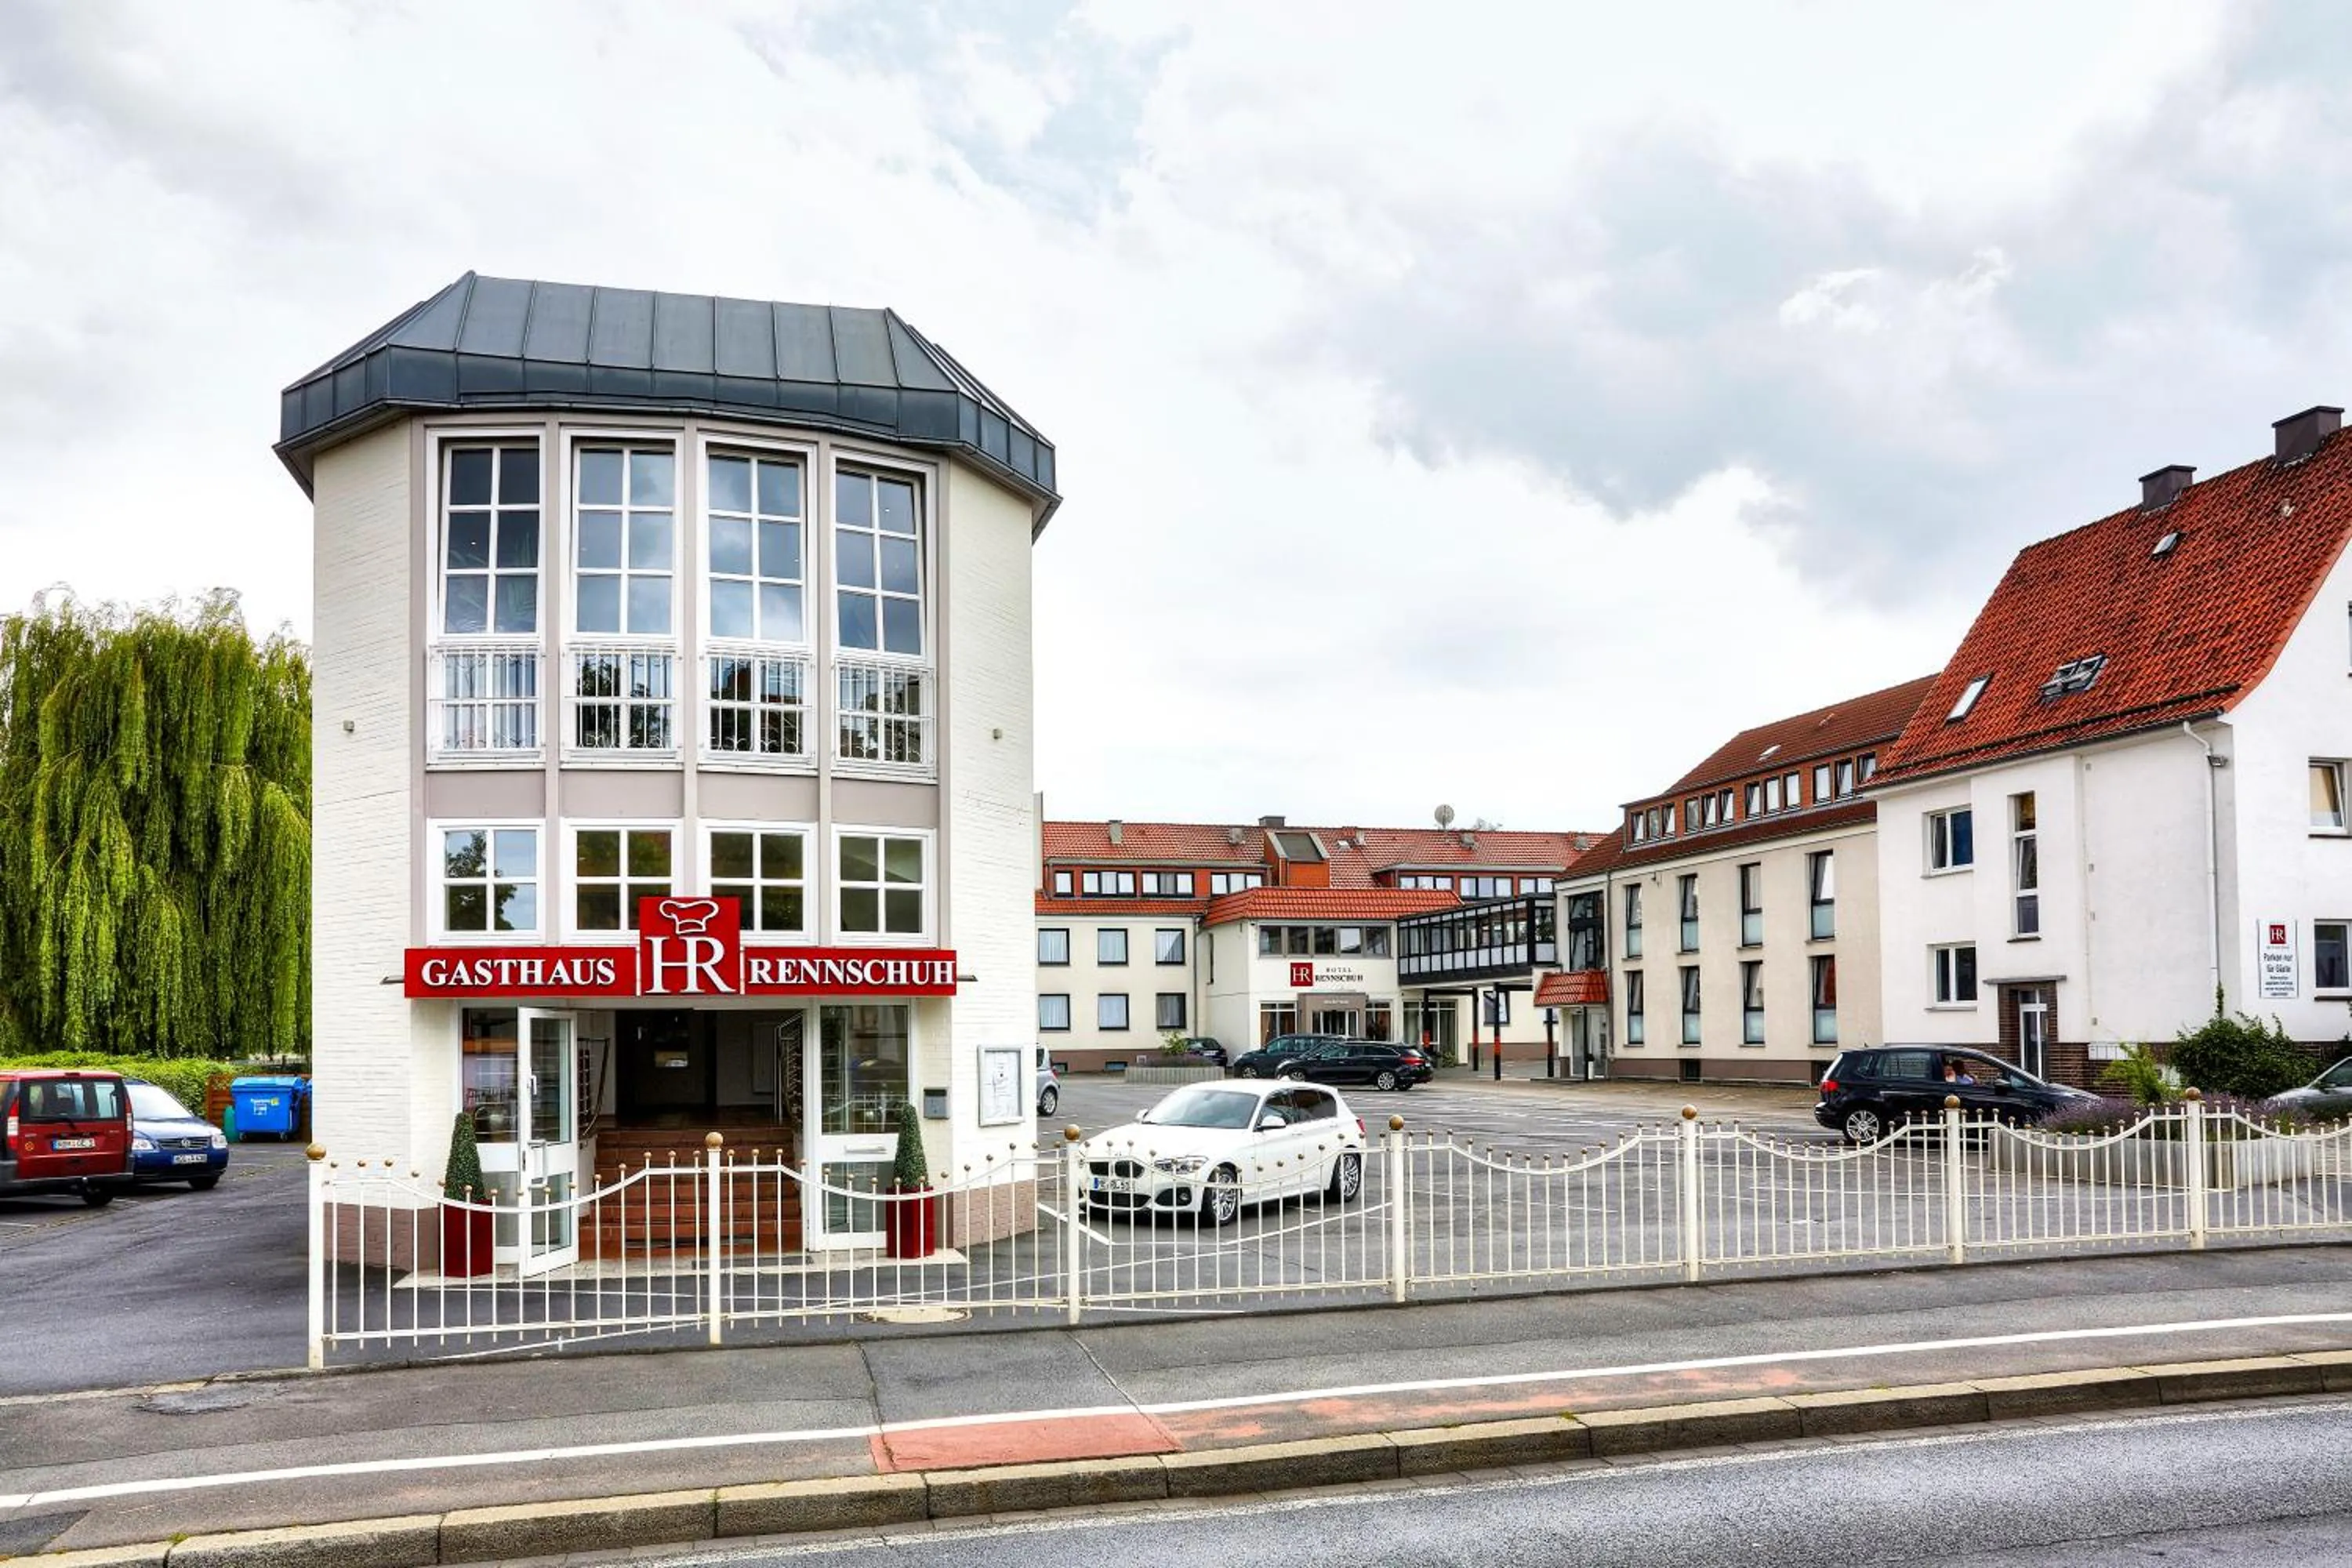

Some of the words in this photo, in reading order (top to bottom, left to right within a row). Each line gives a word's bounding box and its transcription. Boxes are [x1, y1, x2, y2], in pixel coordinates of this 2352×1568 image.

[2270, 928, 2285, 941] HR
[421, 958, 616, 986] GASTHAUS
[644, 935, 737, 994] HR
[748, 958, 955, 985] RENNSCHUH
[1292, 967, 1311, 982] HR
